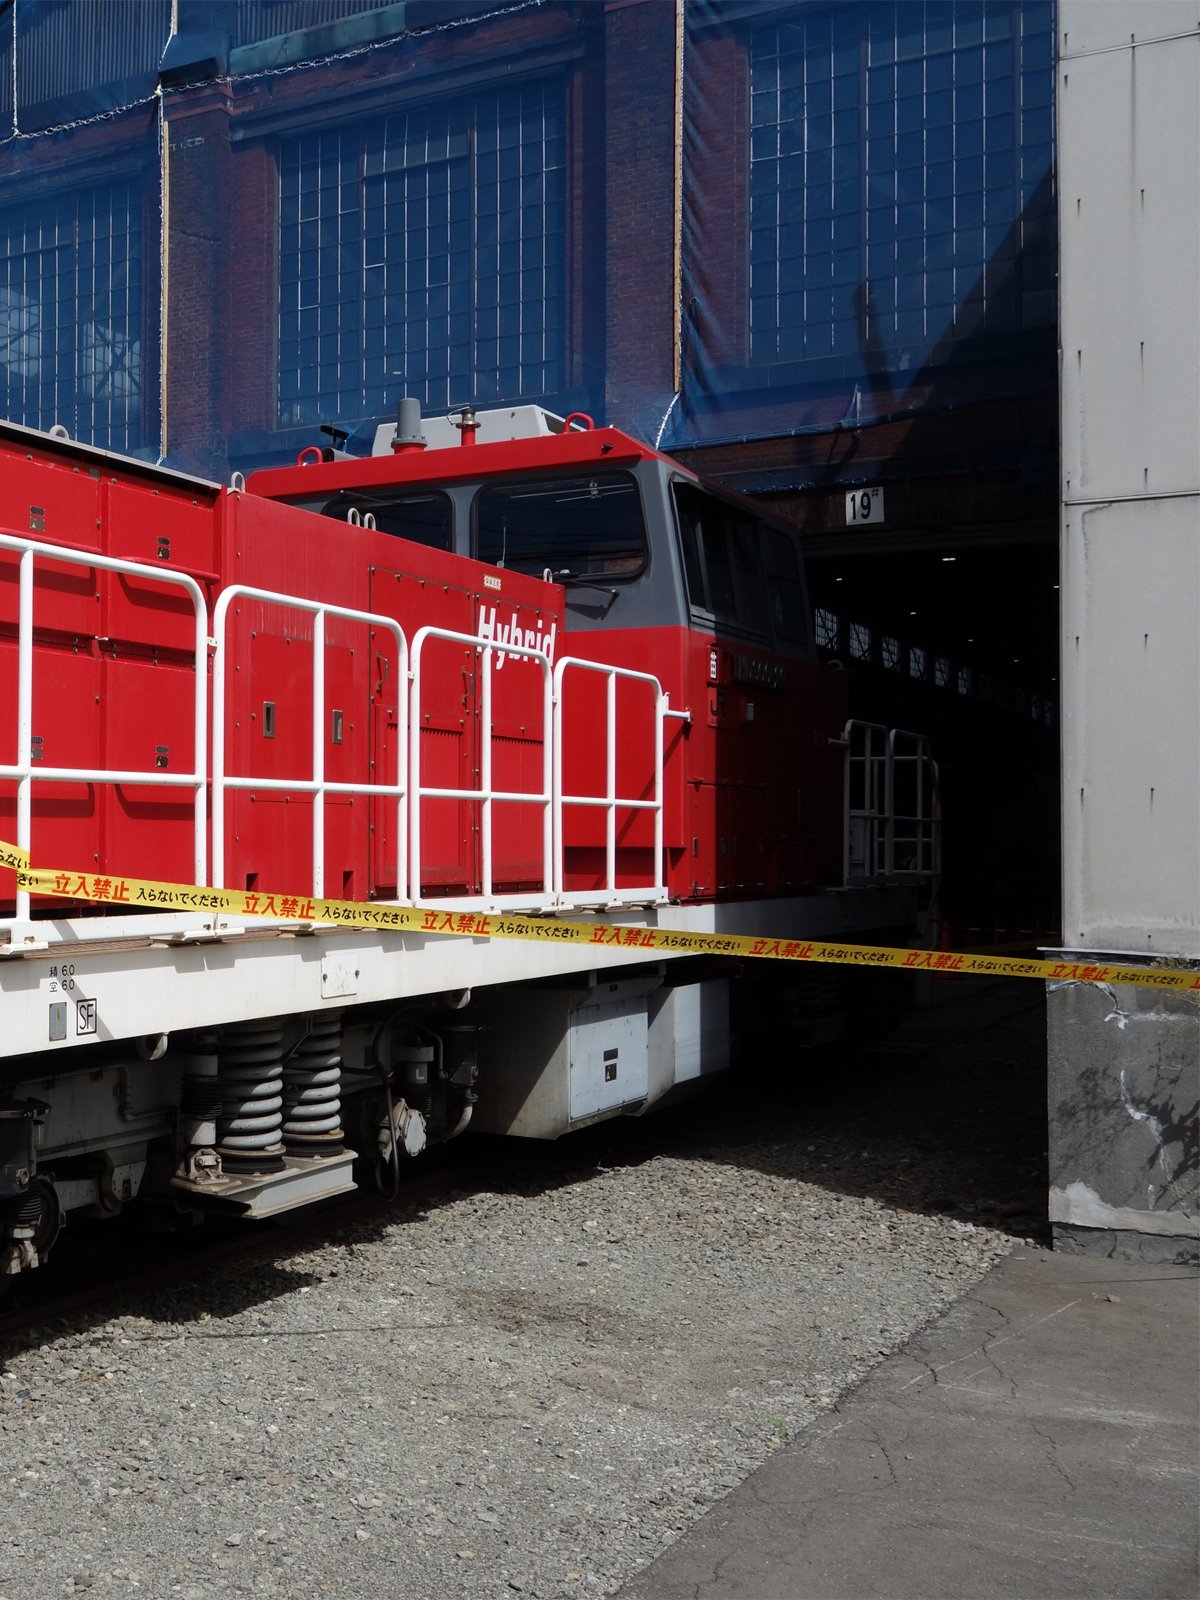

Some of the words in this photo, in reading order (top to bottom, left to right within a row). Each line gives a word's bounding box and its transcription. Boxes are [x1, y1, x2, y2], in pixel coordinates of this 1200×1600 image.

[476, 605, 557, 670] Hybrid
[51, 874, 130, 903] 立入禁止
[136, 887, 230, 908] 入らないでください
[242, 894, 316, 920] 立入禁止
[321, 905, 410, 925] 入らないでください
[420, 911, 491, 935] 立入禁止
[496, 921, 579, 939] 入らないでください
[589, 926, 655, 948] 立入禁止
[660, 935, 741, 952] 入らないでください
[749, 939, 814, 959] 立入禁止
[817, 948, 894, 963] 入らないでください
[902, 951, 966, 971] 立入禁止
[967, 960, 1042, 974] 入らないでください
[1048, 963, 1111, 982] 立入禁止
[1112, 971, 1184, 986] 入らないでください
[61, 964, 75, 977] 6.0
[49, 981, 58, 993] 空
[61, 979, 75, 991] 6.0
[79, 1003, 94, 1030] SF
[415, 1067, 425, 1080] L
